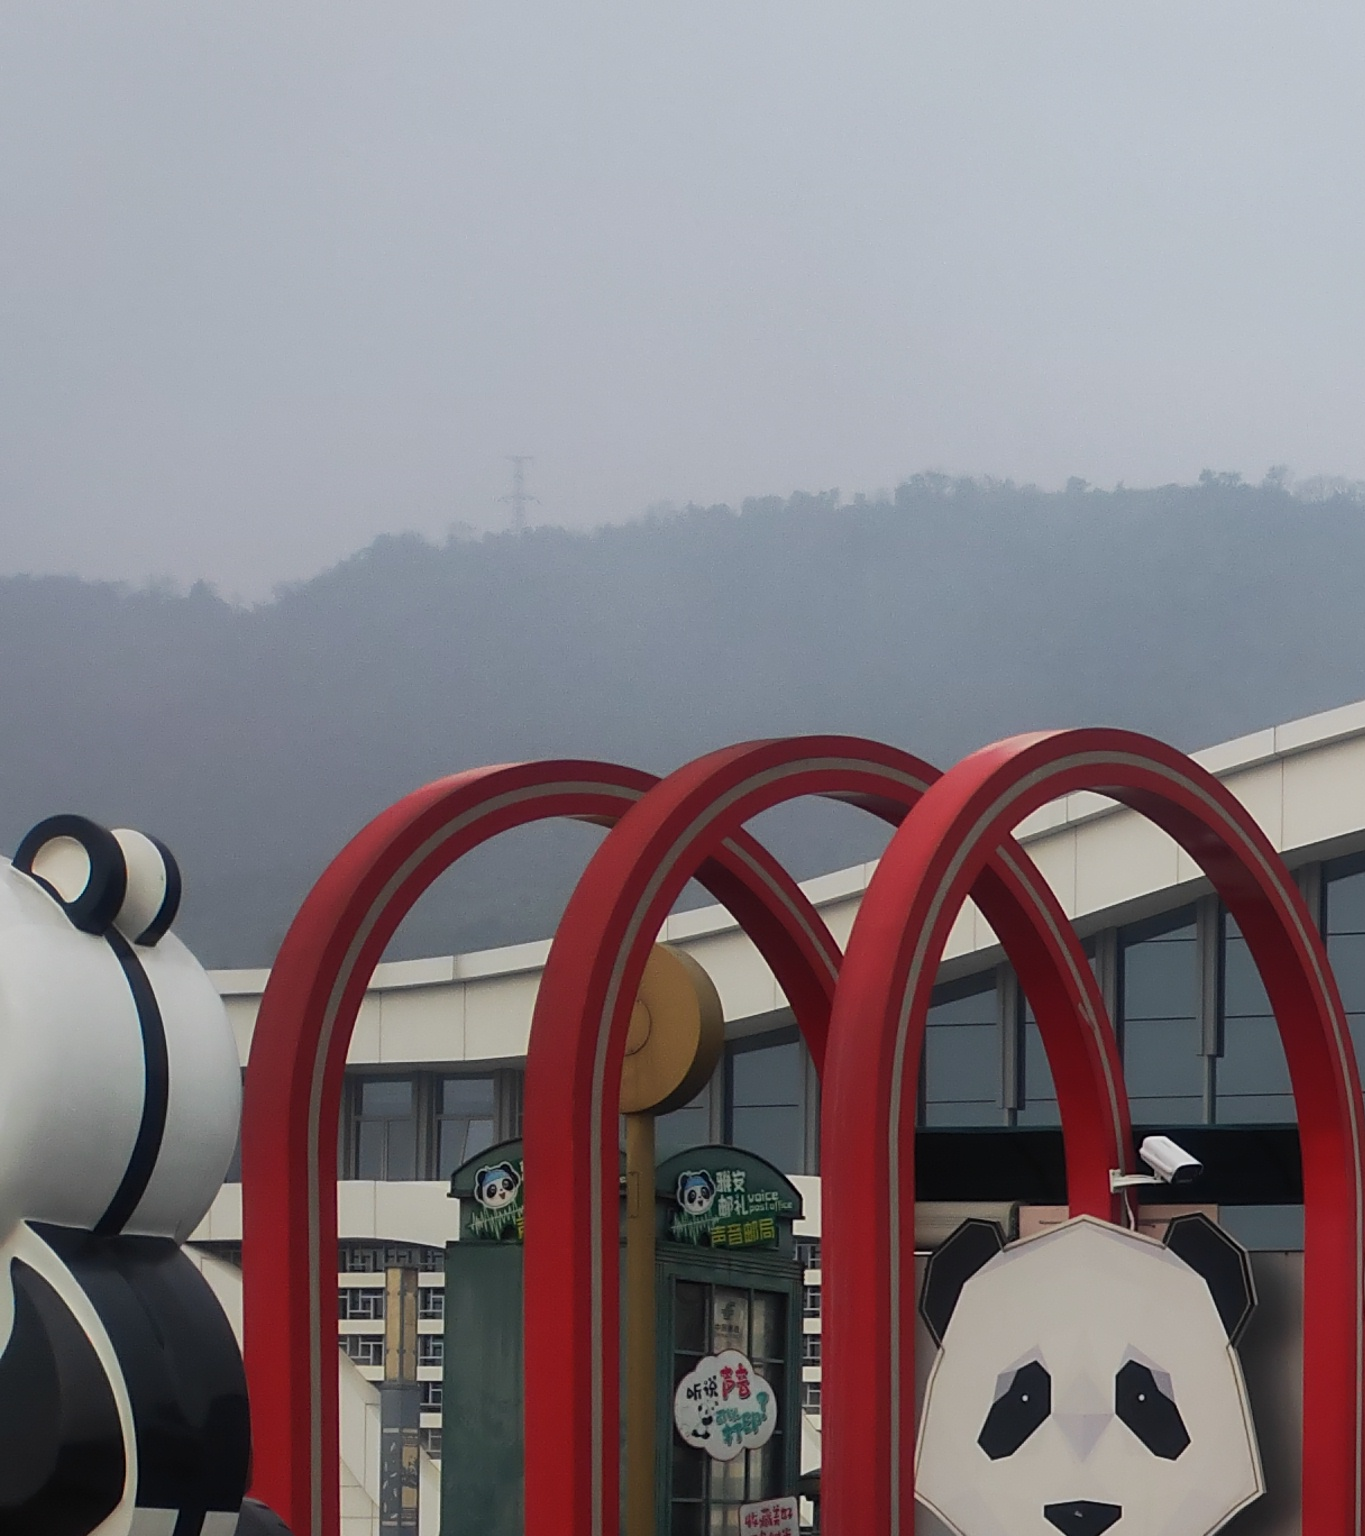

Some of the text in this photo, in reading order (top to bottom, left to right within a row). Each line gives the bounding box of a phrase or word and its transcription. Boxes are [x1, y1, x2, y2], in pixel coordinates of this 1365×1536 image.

[748, 1189, 779, 1203] voice
[710, 1218, 775, 1248] 声音邮局
[687, 1375, 718, 1401] 听说
